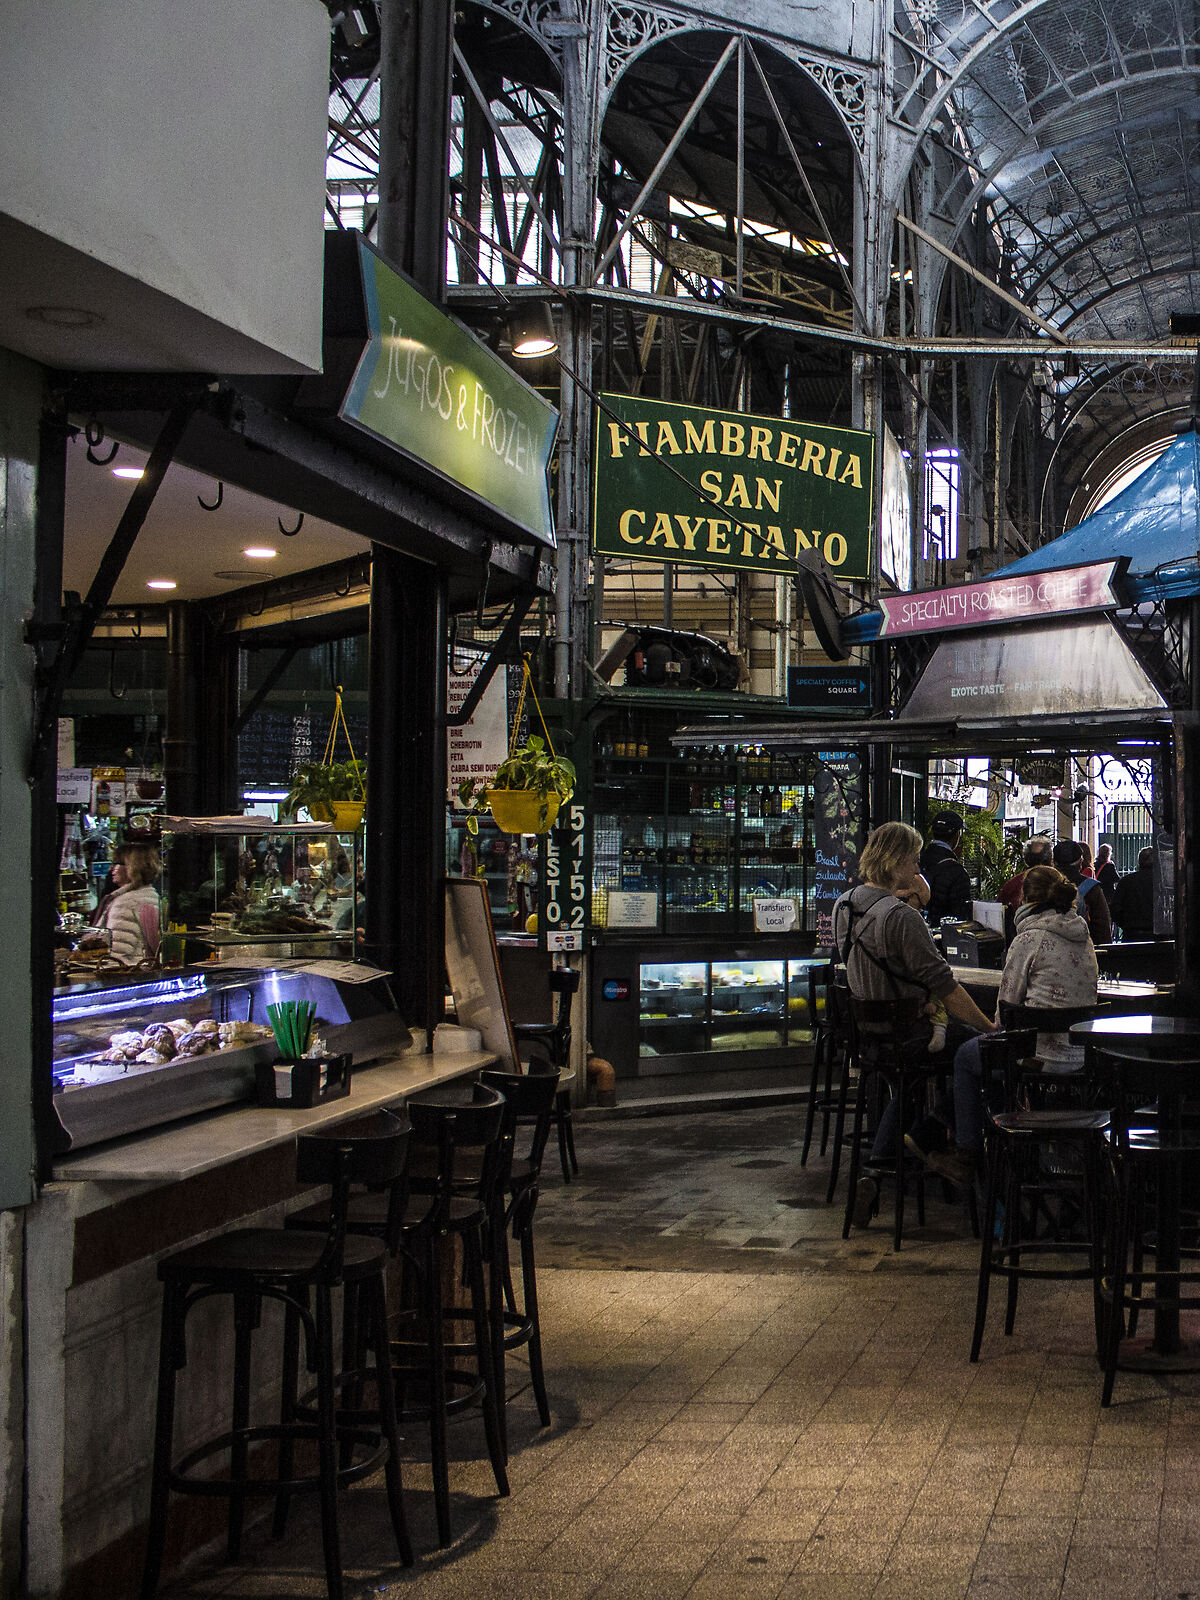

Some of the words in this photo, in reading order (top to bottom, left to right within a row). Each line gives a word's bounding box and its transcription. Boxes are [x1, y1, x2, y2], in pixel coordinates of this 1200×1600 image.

[374, 316, 454, 420] JUGOS
[456, 384, 468, 431] &
[473, 381, 538, 477] FROZEN
[607, 419, 863, 489] FIAMBRERIA
[699, 469, 783, 513] SAN
[618, 509, 848, 566] CAYETANO
[971, 584, 1035, 613] ROASTED
[1037, 575, 1087, 603] COFFEE
[951, 686, 978, 697] EXOTIC
[980, 684, 1005, 695] TASTE
[451, 753, 464, 761] FETA
[451, 764, 469, 772] CABRA
[471, 764, 485, 772] SEMI
[766, 917, 785, 926] Local
